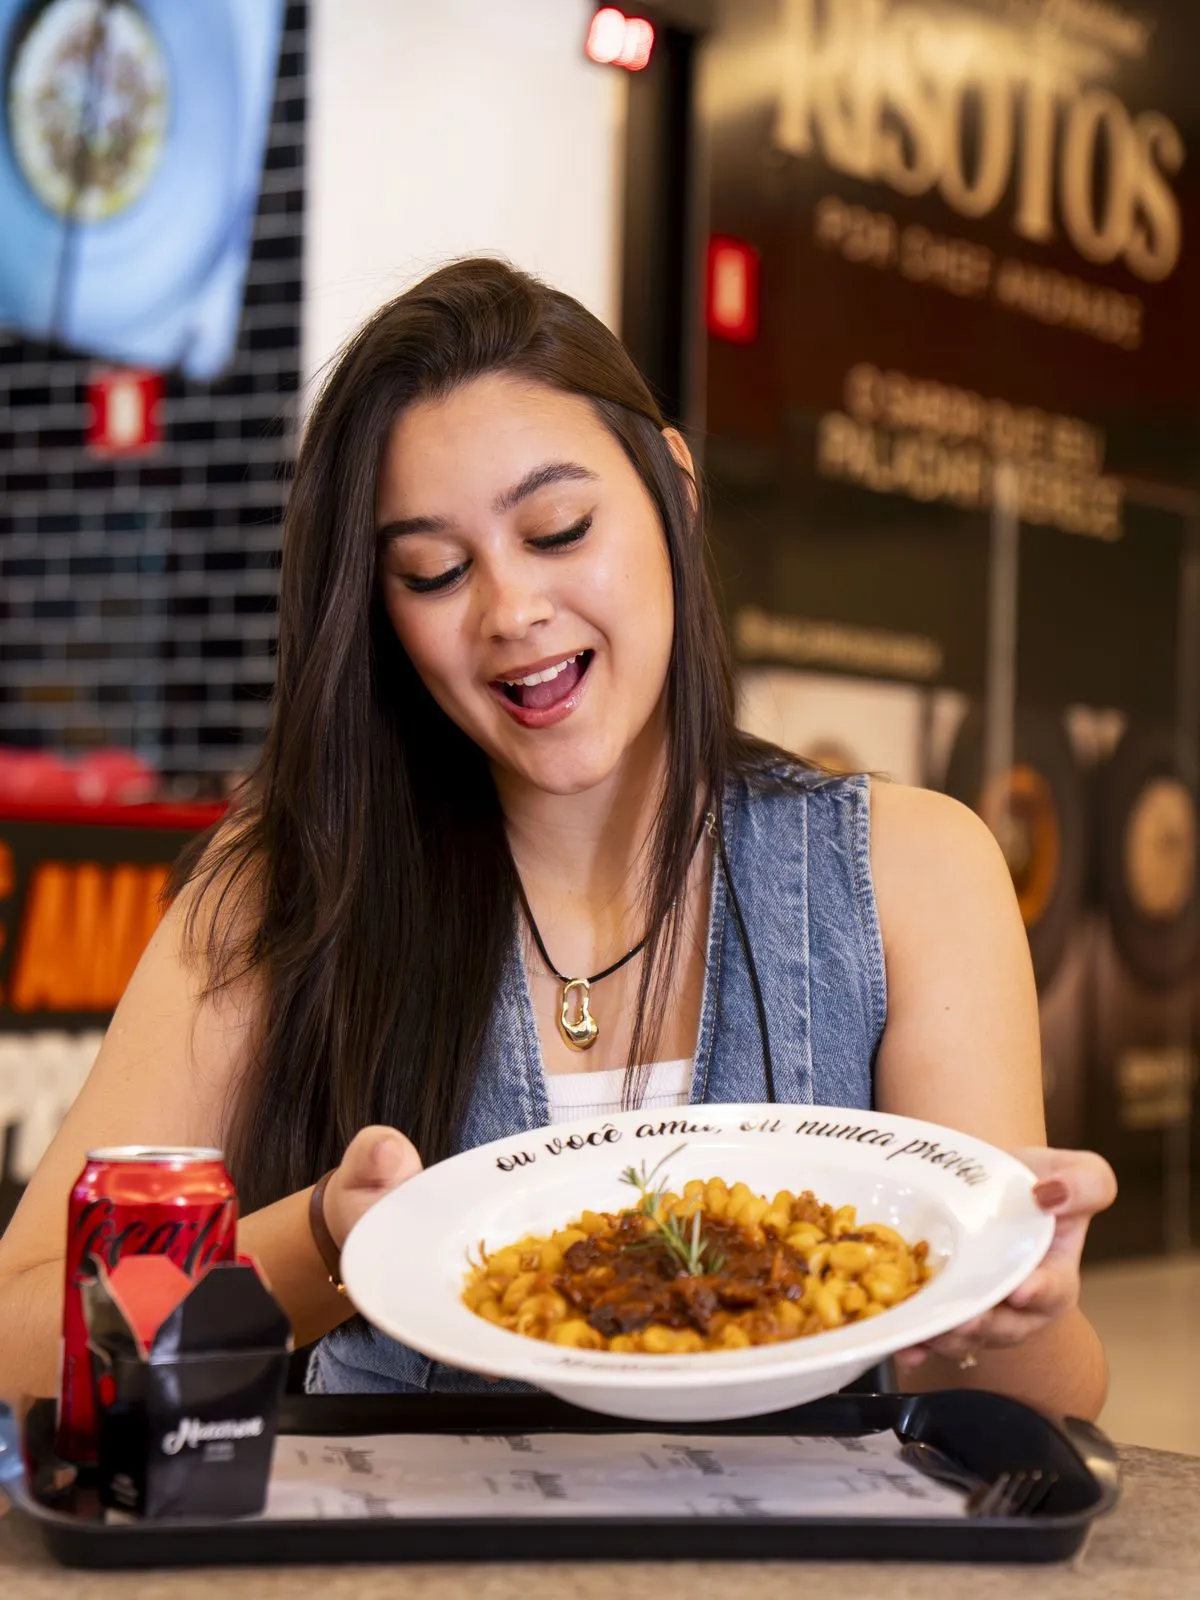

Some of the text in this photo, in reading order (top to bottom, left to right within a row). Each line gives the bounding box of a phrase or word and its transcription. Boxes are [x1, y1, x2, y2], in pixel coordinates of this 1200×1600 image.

[496, 1150, 537, 1172] ou
[545, 1122, 623, 1156] você
[795, 1118, 896, 1148] nunca
